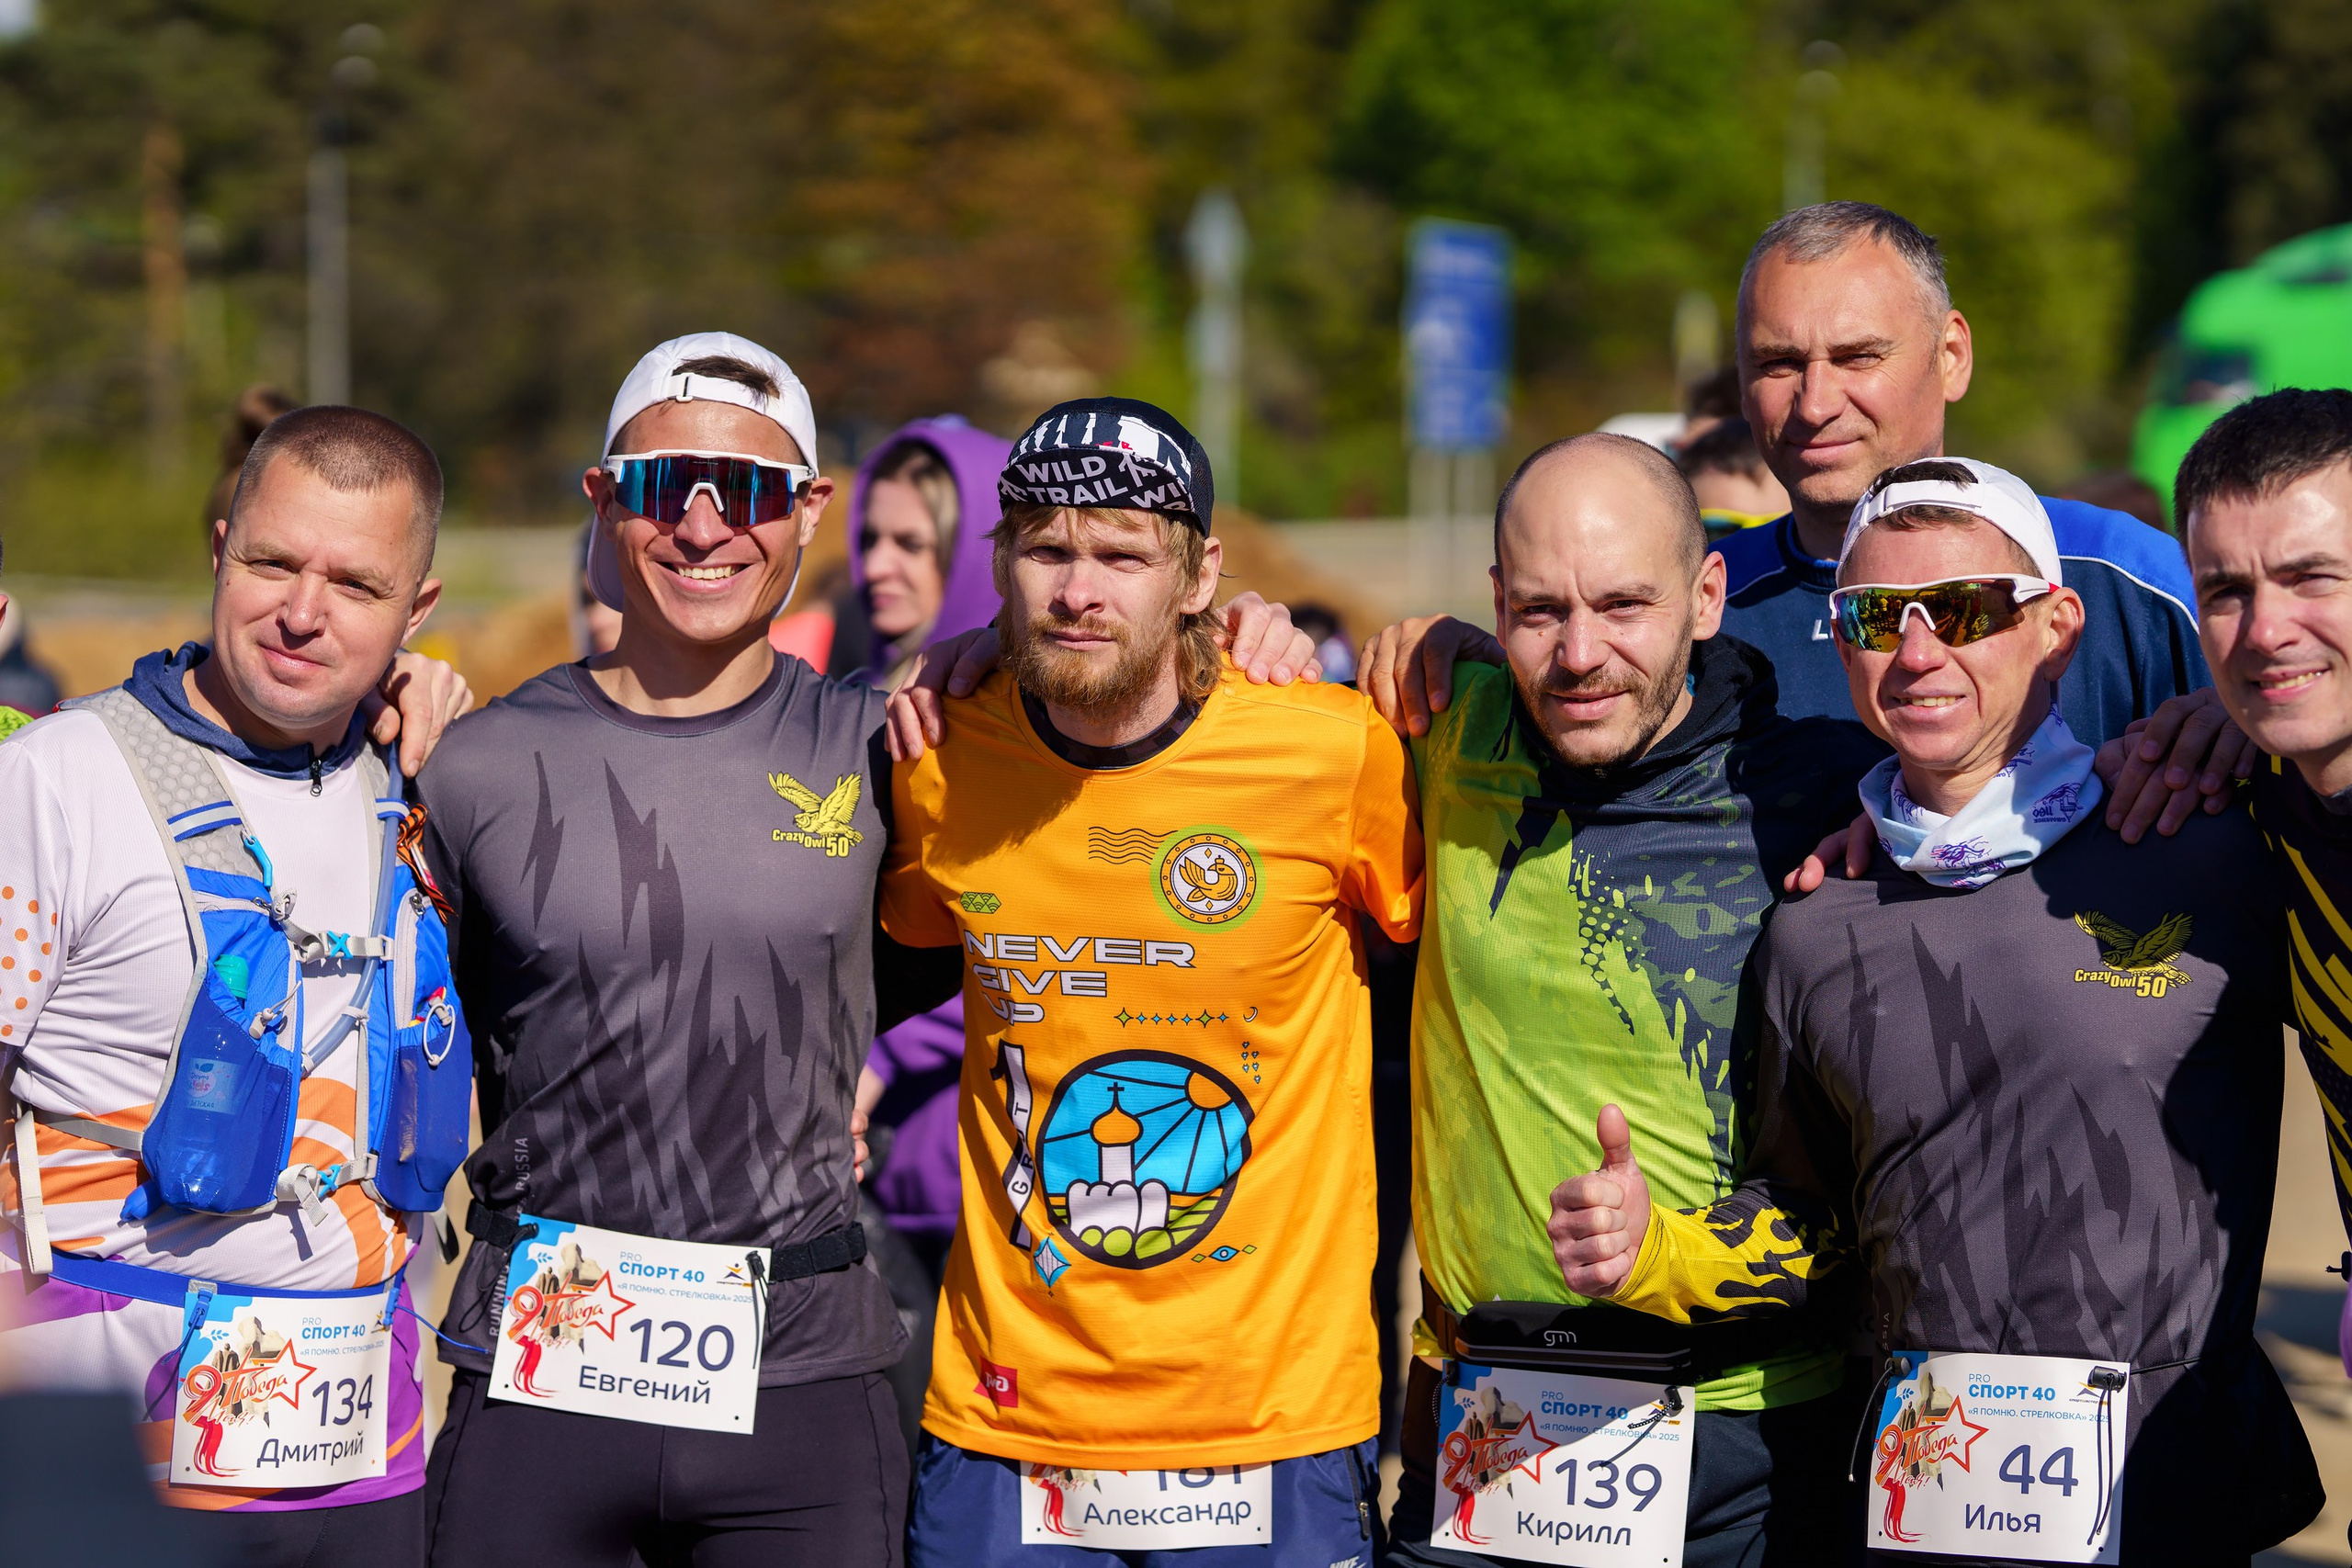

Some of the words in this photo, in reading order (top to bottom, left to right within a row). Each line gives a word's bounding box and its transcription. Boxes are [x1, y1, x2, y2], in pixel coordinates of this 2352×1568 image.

[1015, 456, 1107, 483] WILD
[1026, 477, 1129, 505] TRAIL
[825, 837, 849, 858] 50
[964, 929, 1197, 968] NEVER
[972, 963, 1108, 998] GIVE
[2135, 976, 2167, 998] 50
[981, 991, 1046, 1026] UP
[514, 1137, 531, 1190] RUSSIA
[620, 1251, 642, 1262] PRO
[619, 1261, 679, 1280] СПОРТ
[683, 1269, 705, 1283] 40
[301, 1325, 350, 1339] СПОРТ
[352, 1325, 366, 1337] 40
[302, 1317, 322, 1325] PRO
[629, 1318, 735, 1371] 120
[578, 1365, 711, 1405] Евгений
[1968, 1373, 1991, 1382] PRO
[312, 1374, 372, 1427] 134
[1542, 1391, 1564, 1401] PRO
[1969, 1383, 2029, 1400] СПОРТ
[2032, 1387, 2055, 1401] 40
[1541, 1401, 1602, 1418] СПОРТ
[1605, 1407, 1628, 1420] 40
[2020, 1409, 2086, 1421] СТРЕЛКОВКА»
[256, 1430, 364, 1468] Дмитрий
[1658, 1433, 1679, 1441] 2025
[1999, 1444, 2078, 1496] 44
[1555, 1458, 1662, 1512] 139
[1083, 1500, 1251, 1526] Александр
[1965, 1503, 2041, 1533] Илья
[1517, 1511, 1632, 1546] Кирилл
